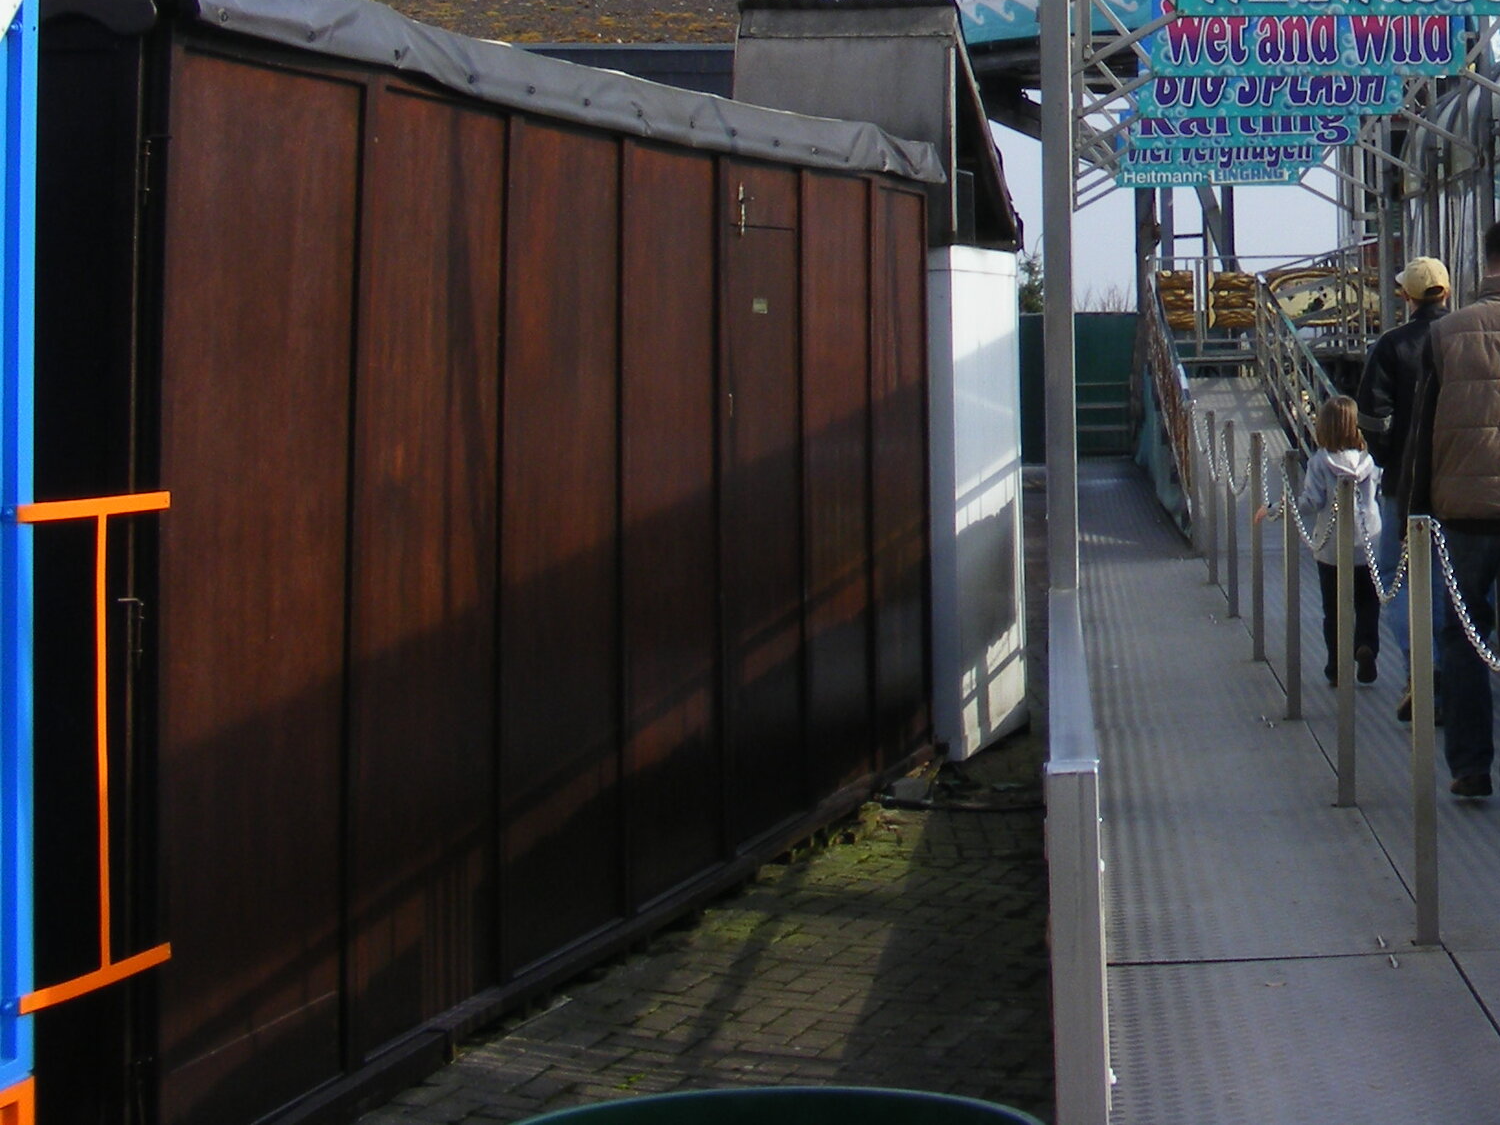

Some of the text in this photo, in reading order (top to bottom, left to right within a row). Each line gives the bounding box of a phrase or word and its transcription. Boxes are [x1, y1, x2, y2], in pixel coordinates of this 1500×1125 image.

[1161, 3, 1452, 66] Wet and Wild
[1235, 75, 1386, 106] SPLASH
